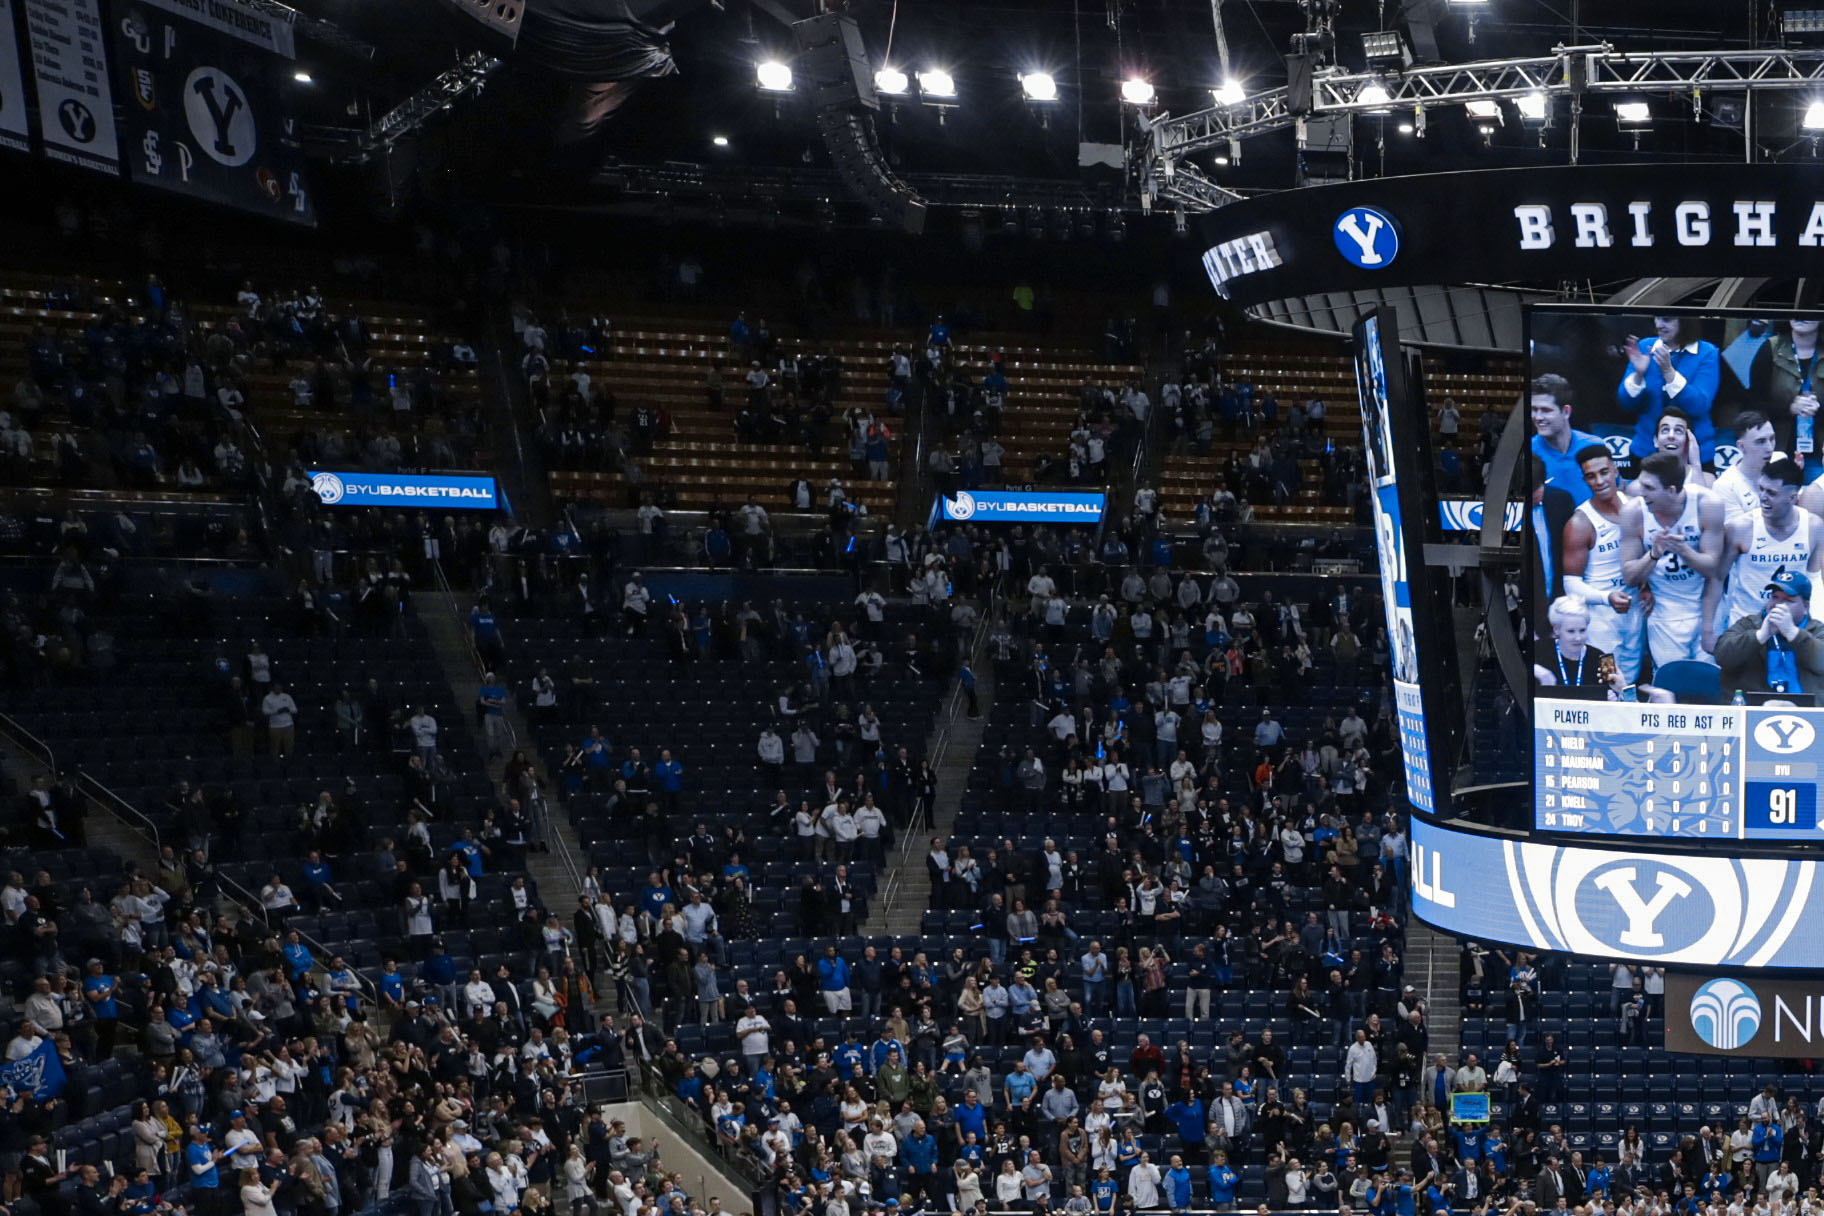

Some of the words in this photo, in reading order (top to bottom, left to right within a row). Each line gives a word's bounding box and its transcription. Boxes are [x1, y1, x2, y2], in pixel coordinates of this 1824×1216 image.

[193, 77, 242, 156] Y
[1338, 213, 1383, 264] Y
[1751, 553, 1808, 563] BRIGHAM
[1555, 710, 1589, 724] PLAYER
[1642, 714, 1659, 727] PTS
[1668, 715, 1686, 728] REB
[1695, 716, 1713, 729] AST
[1723, 717, 1734, 729] PF
[1767, 720, 1804, 748] Y
[1770, 789, 1796, 824] 91
[1594, 866, 1693, 948] Y
